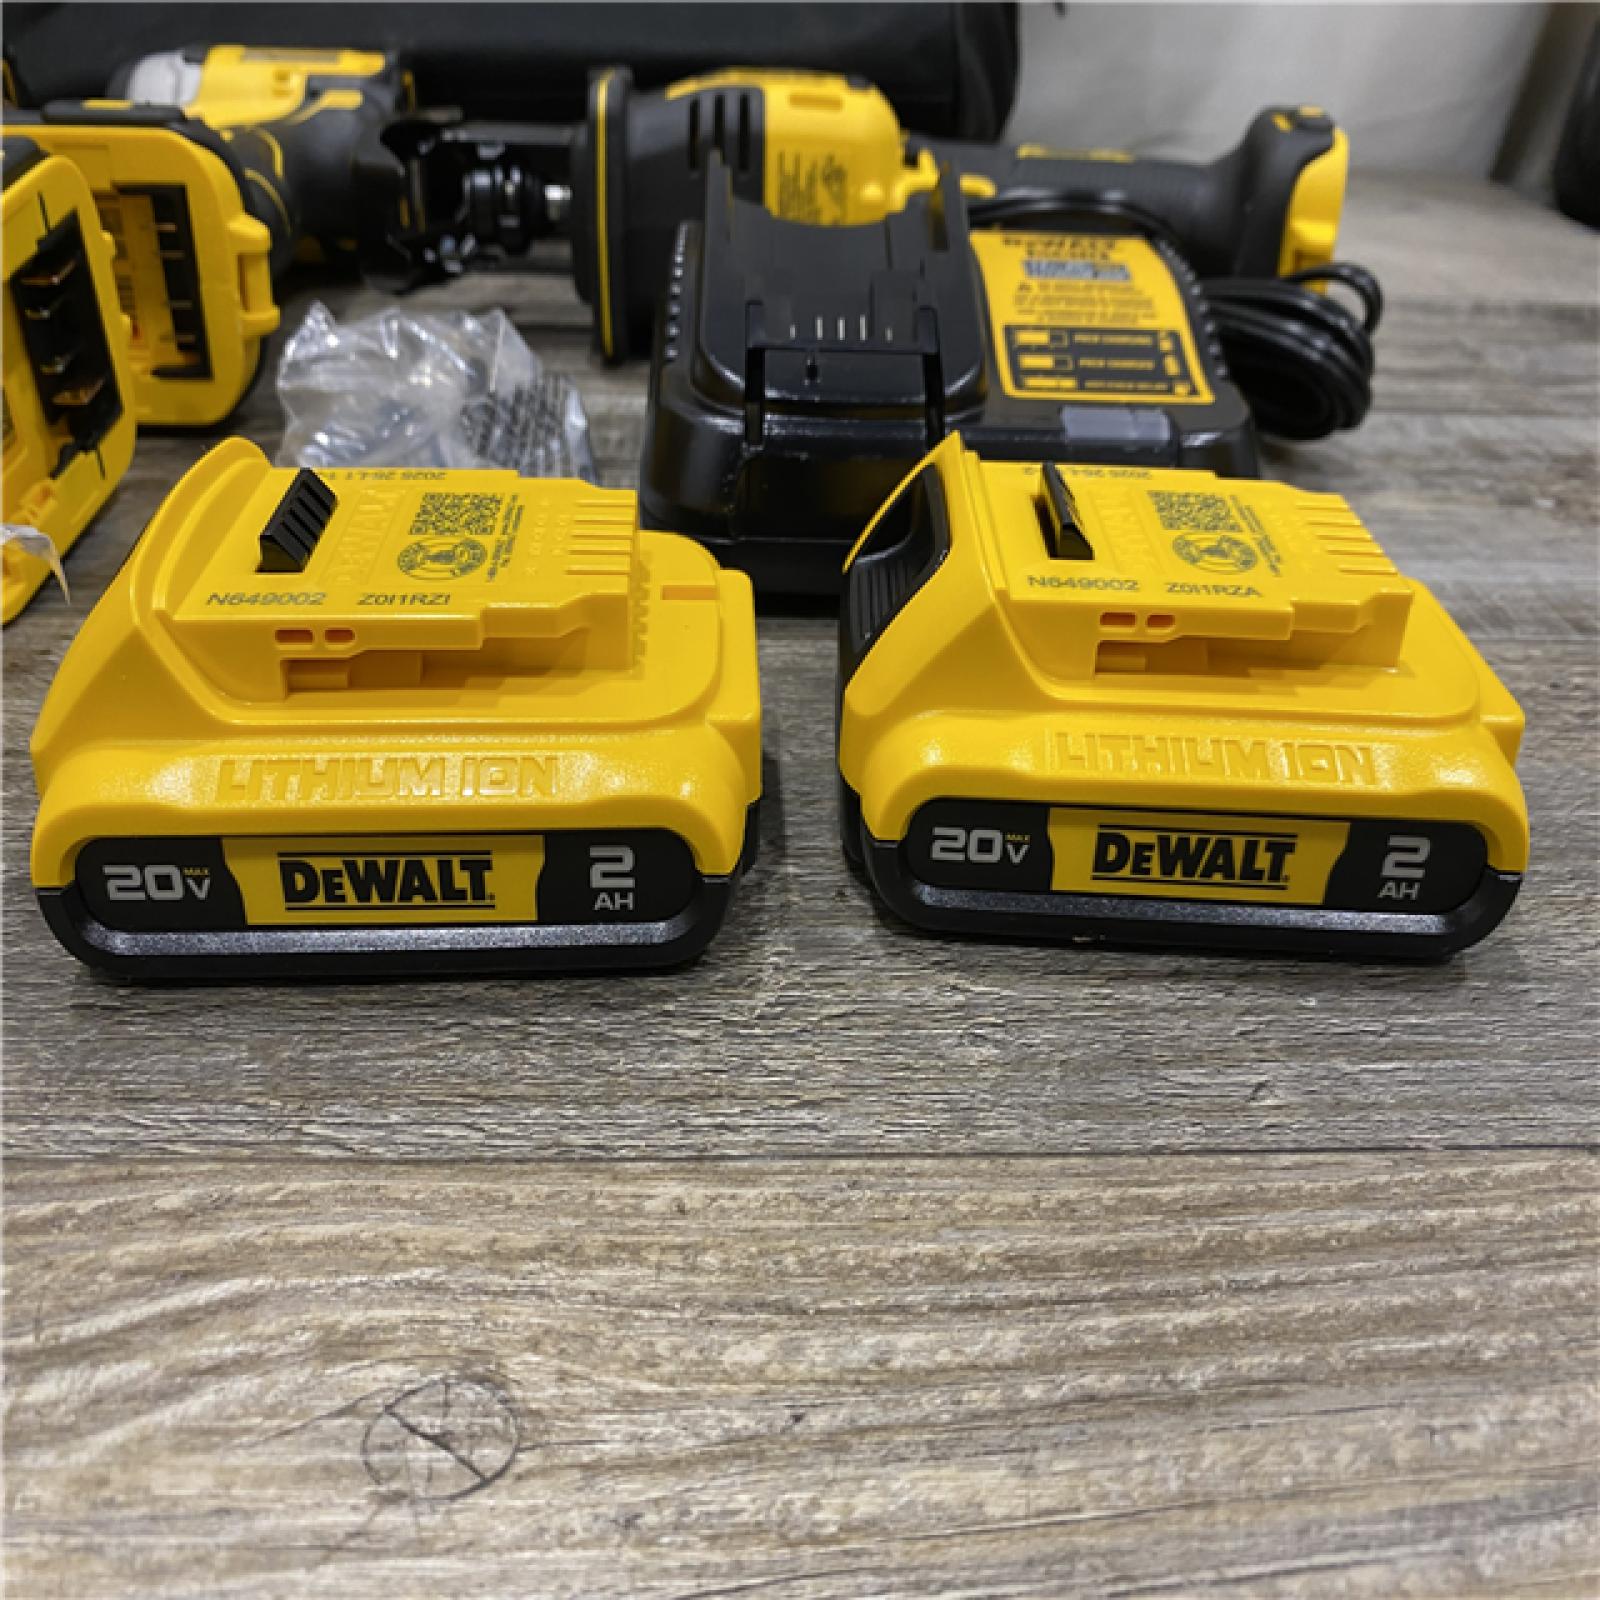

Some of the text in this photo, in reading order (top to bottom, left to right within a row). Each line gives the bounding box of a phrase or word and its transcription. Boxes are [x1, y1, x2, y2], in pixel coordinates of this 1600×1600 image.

[218, 756, 558, 801] LITHIUM ION
[1056, 732, 1375, 785] LITHIUM ION
[590, 846, 636, 888] 2
[1383, 836, 1430, 878] 2
[594, 892, 634, 910] AH
[1379, 880, 1418, 900] AH
